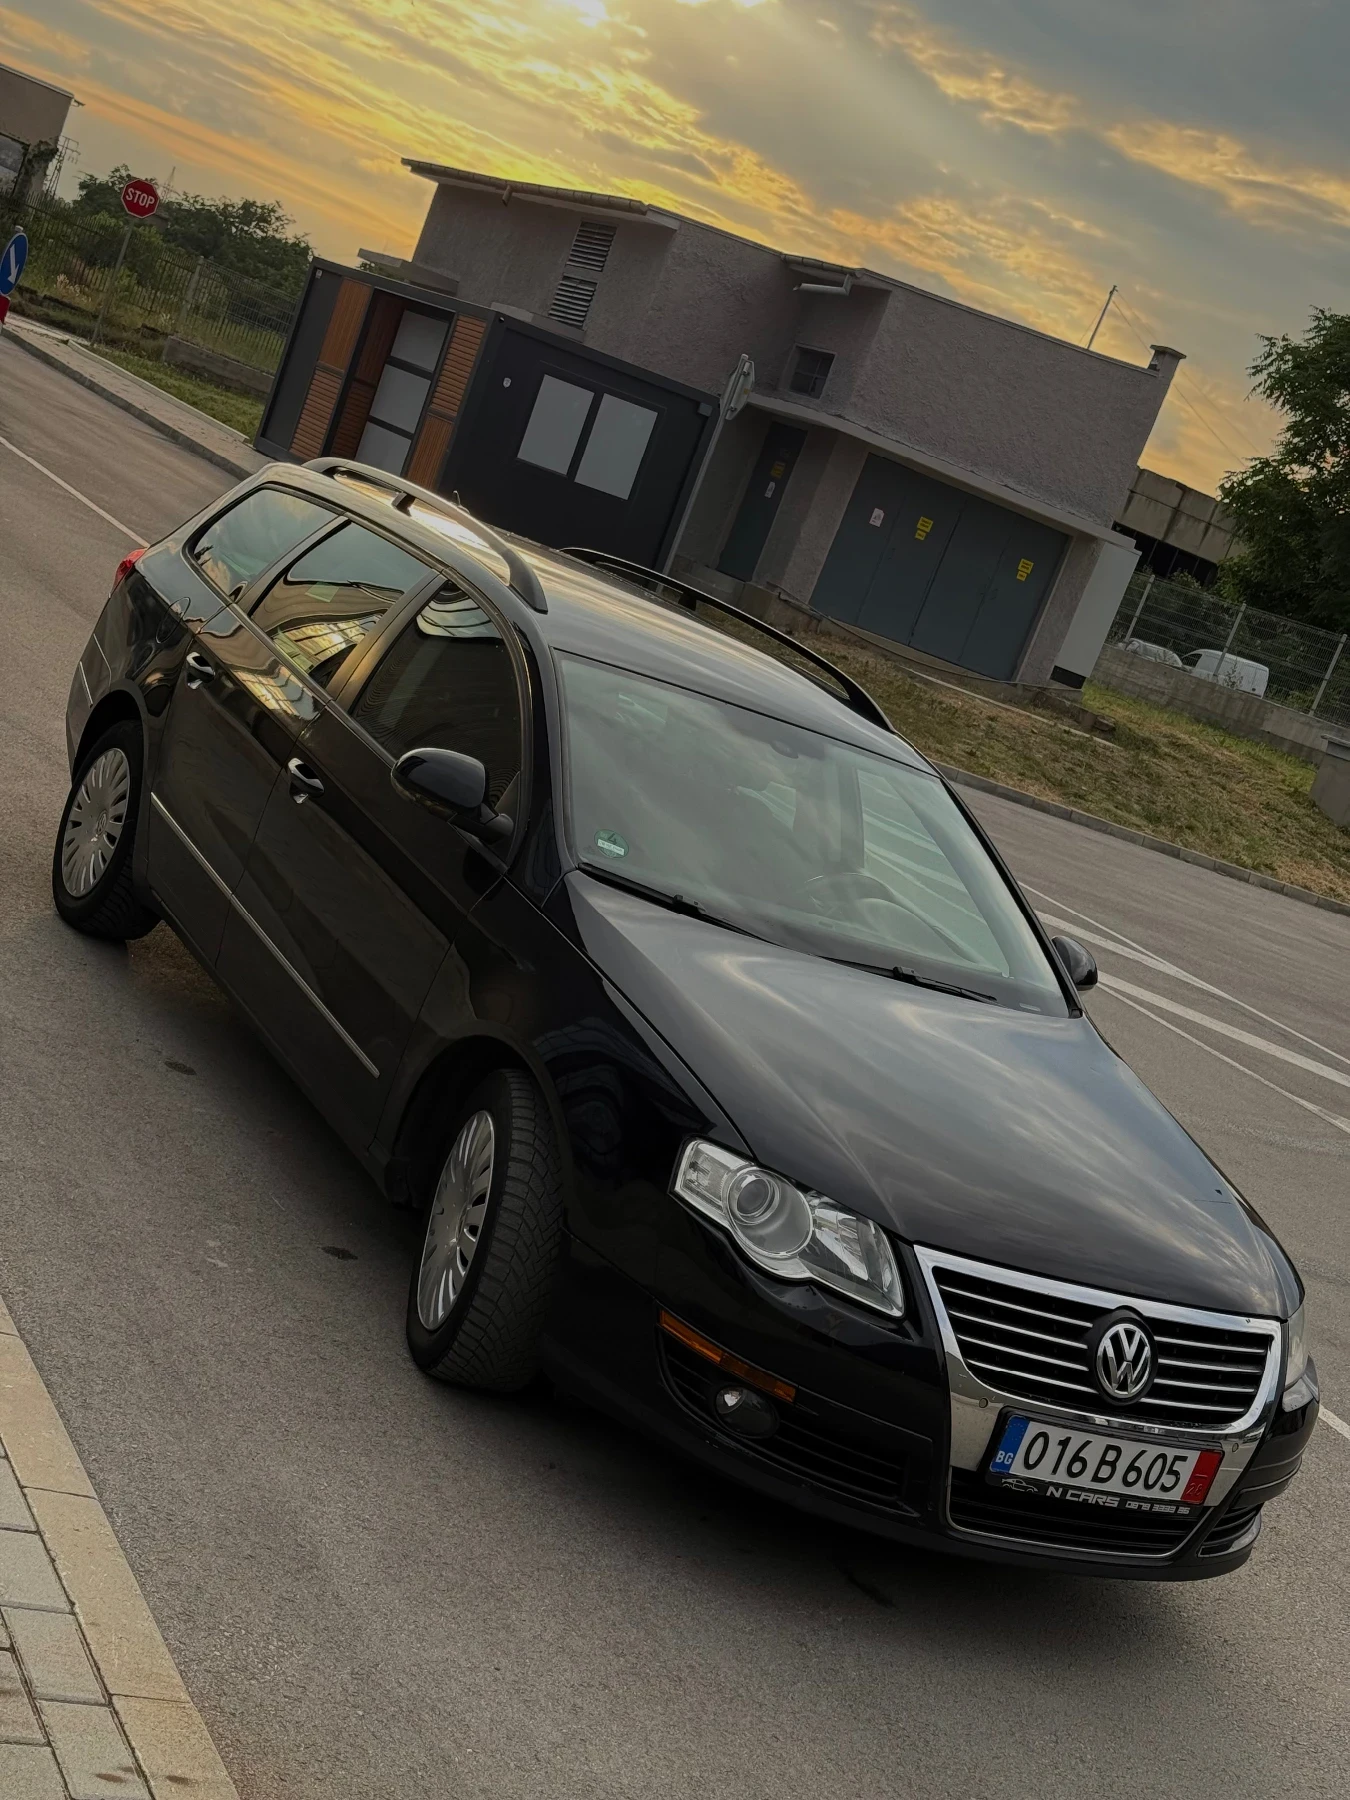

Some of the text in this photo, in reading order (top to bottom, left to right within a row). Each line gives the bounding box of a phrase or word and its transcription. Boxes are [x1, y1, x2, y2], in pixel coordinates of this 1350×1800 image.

[126, 187, 155, 208] STOP
[607, 832, 617, 845] 4
[995, 1450, 1014, 1465] BG
[1046, 1486, 1063, 1498] N
[1065, 1489, 1121, 1508] CARS
